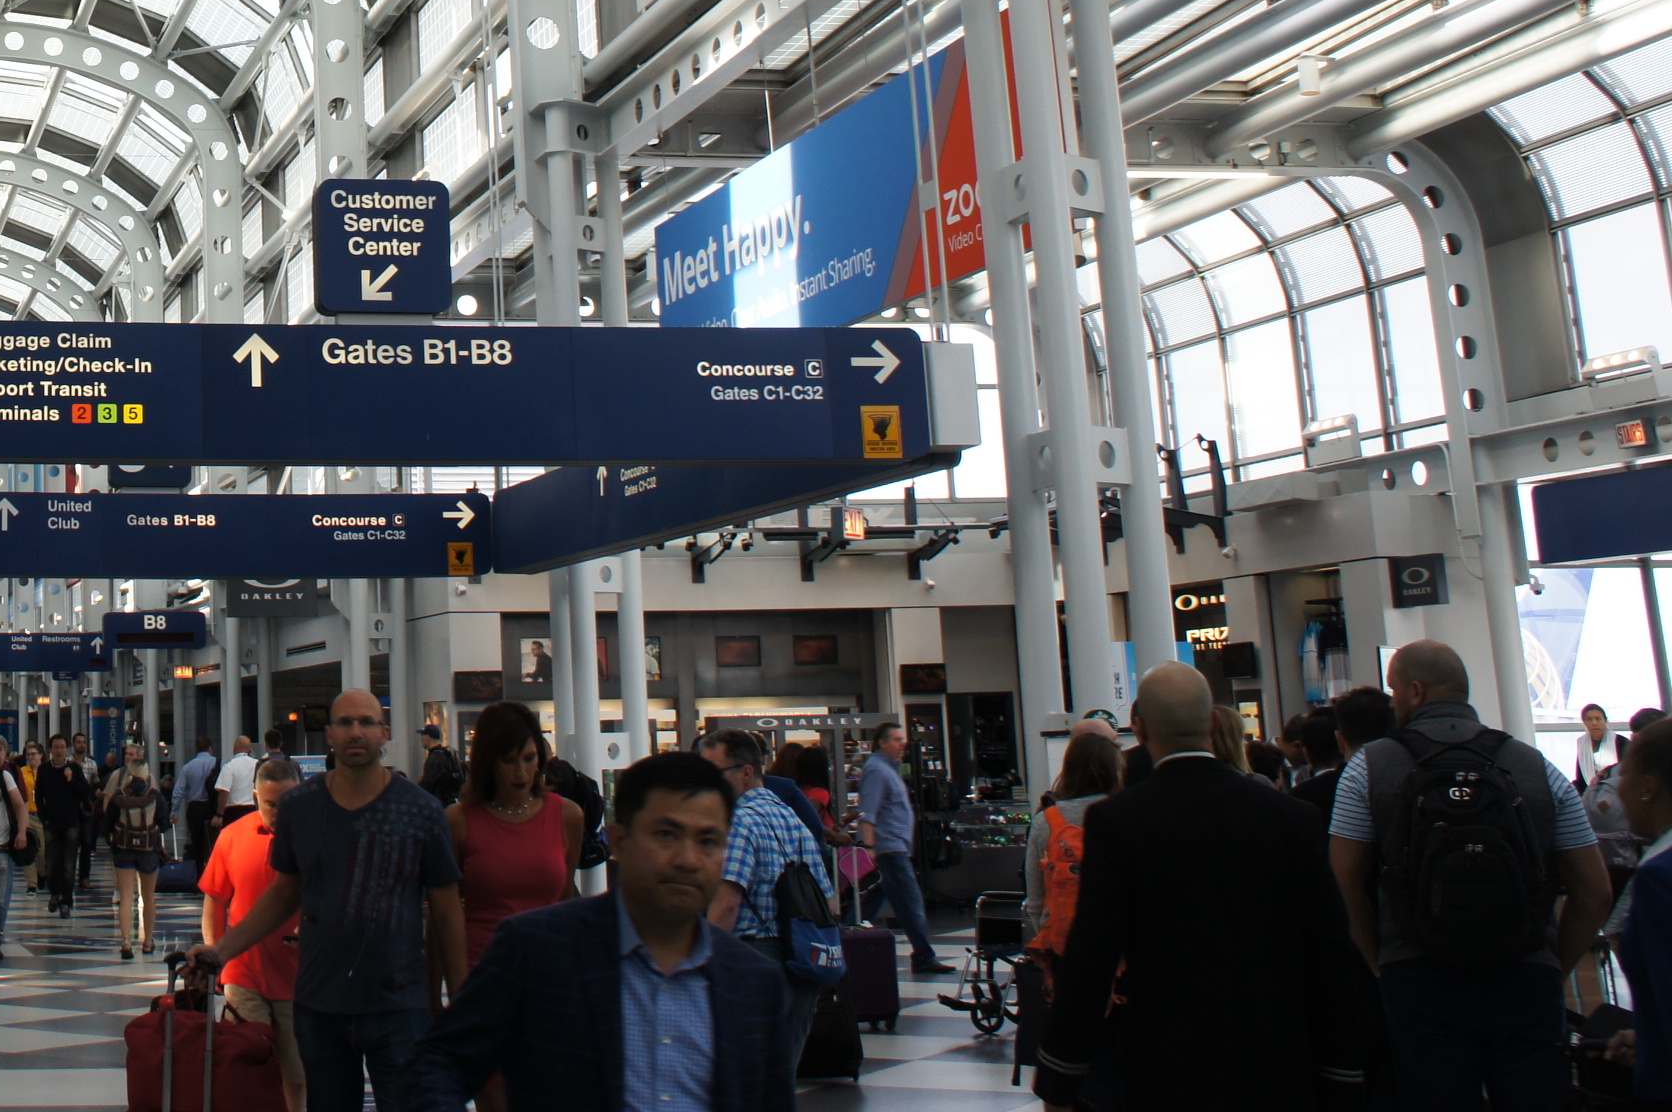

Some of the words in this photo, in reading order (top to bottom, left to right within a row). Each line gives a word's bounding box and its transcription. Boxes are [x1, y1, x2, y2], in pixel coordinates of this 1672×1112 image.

[330, 189, 436, 209] Customer
[943, 183, 980, 226] zo
[343, 213, 425, 233] Service
[348, 236, 422, 256] Center
[947, 231, 975, 252] Video
[663, 236, 719, 305] Meet
[723, 195, 810, 276] Happy.
[828, 247, 876, 287] Sharing.
[57, 332, 112, 348] Claim
[321, 338, 413, 365] Gates
[423, 339, 512, 365] B1-B8
[696, 361, 795, 377] Concourse
[807, 361, 821, 376] C
[40, 381, 107, 397] Transit
[710, 385, 759, 401] Gates
[763, 385, 824, 400] C1-C32
[77, 407, 87, 420] 2
[102, 407, 113, 420] 3
[128, 407, 138, 420] 5
[47, 499, 92, 512] United
[47, 517, 81, 529] Club
[126, 514, 169, 526] Gates
[173, 514, 216, 527] B1-B8
[312, 514, 387, 527] Concourse
[843, 509, 863, 533] EXIT
[333, 530, 365, 541] Gates
[366, 530, 406, 540] C1-C32
[240, 592, 304, 600] OAKLEY
[143, 614, 167, 630] B8
[41, 635, 82, 643] Restrooms
[785, 716, 862, 727] OAKLEY
